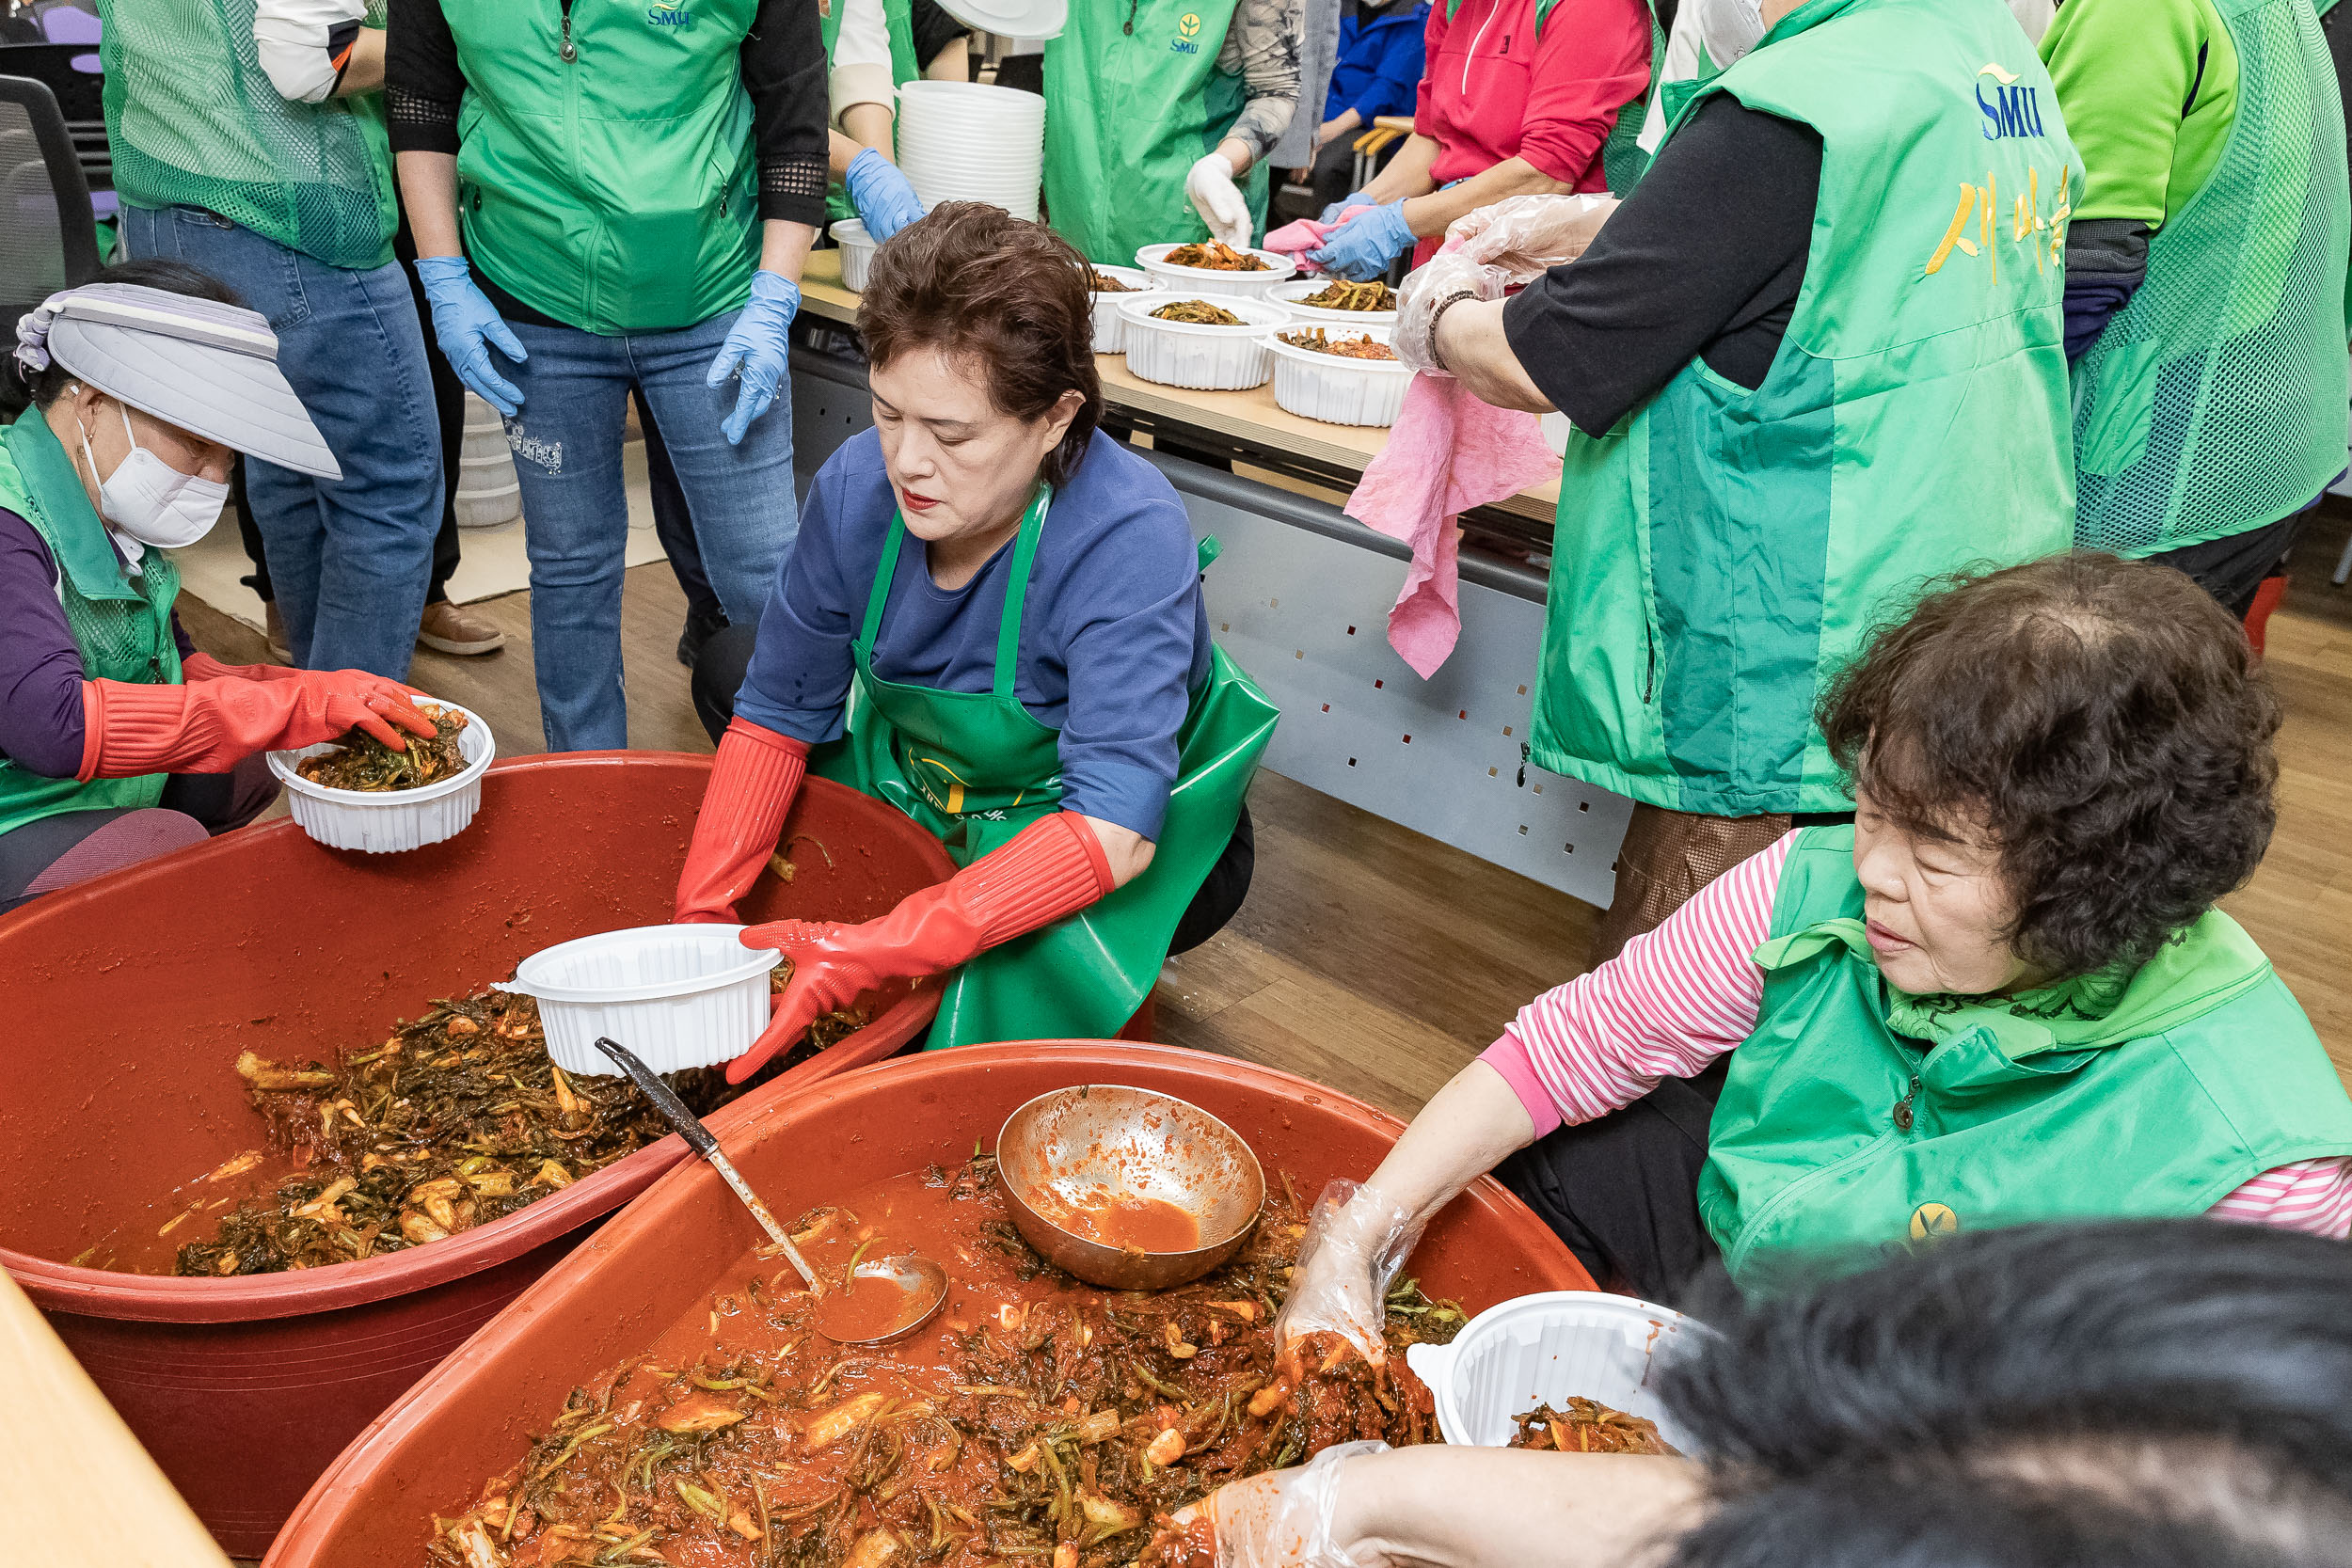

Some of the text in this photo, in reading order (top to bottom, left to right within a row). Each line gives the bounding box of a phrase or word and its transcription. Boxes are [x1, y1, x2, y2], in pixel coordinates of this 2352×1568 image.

[648, 8, 691, 26] SMU
[1169, 39, 1200, 55] SMU
[1976, 82, 2045, 141] SMU
